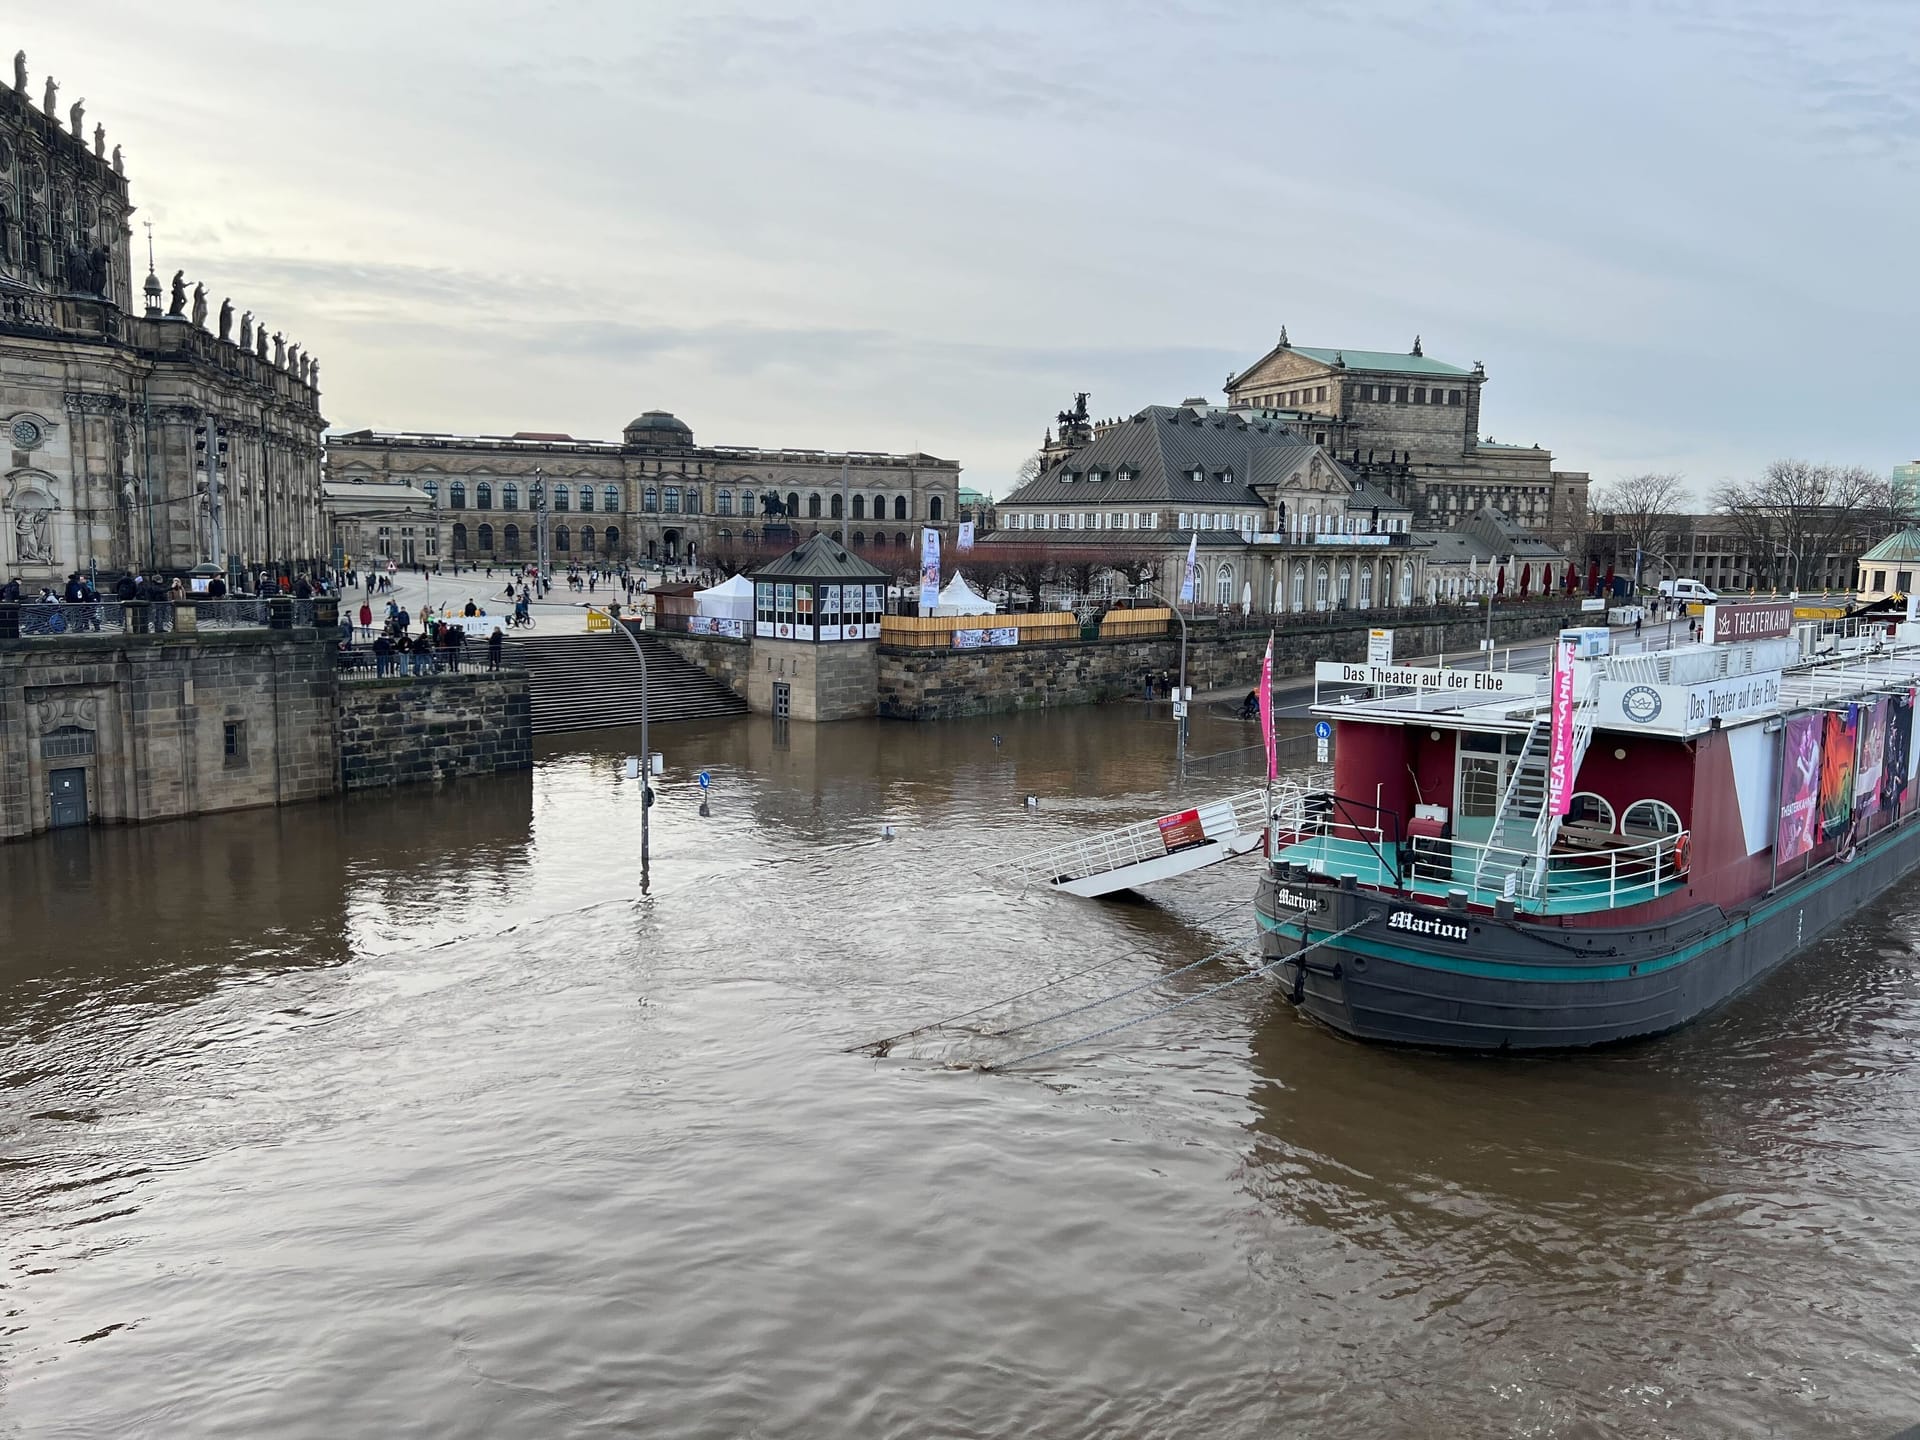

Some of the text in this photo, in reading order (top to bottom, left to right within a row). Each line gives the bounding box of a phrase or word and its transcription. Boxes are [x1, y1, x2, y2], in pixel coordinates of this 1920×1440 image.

[1734, 609, 1791, 635] THEATERKAHN
[1343, 665, 1503, 691] Das Theater auf der Elbe
[1690, 693, 1705, 721] Das
[1708, 688, 1736, 717] Theater
[1737, 682, 1750, 710] auf
[1751, 681, 1763, 707] der
[1764, 678, 1778, 705] Elbe
[1549, 670, 1572, 813] THEATERKAHN
[1278, 888, 1318, 912] Marion
[1388, 911, 1469, 940] Marion
